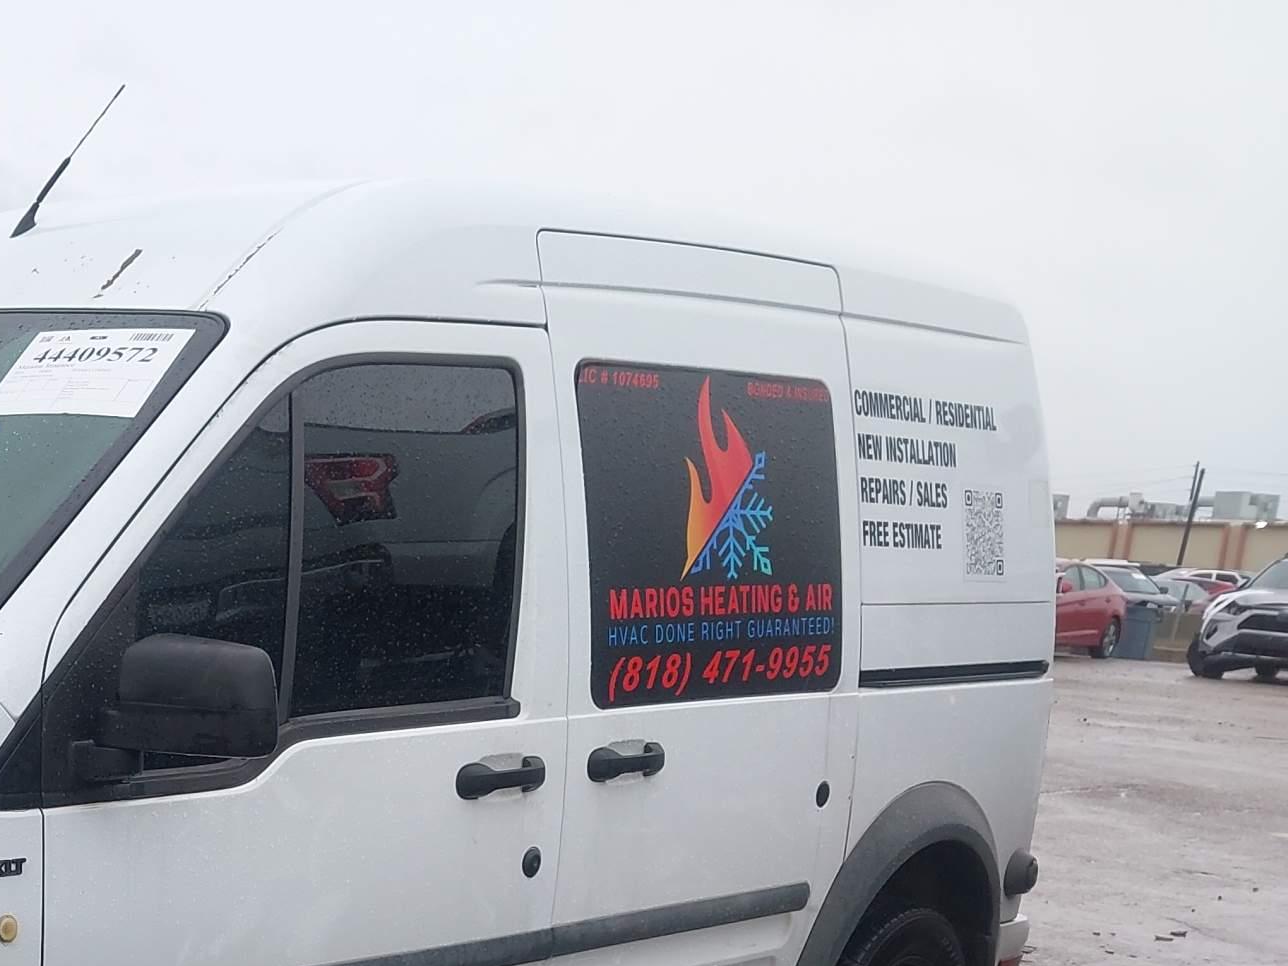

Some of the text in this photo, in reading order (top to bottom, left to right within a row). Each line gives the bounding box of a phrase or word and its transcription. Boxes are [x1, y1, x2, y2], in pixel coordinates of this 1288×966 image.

[33, 346, 159, 364] 44409572
[600, 368, 609, 385] #
[854, 389, 997, 431] COMMERCIAL / RESIDENTIAL
[858, 433, 957, 468] NEW INSTALLATION
[860, 476, 948, 509] REPAIRS / SALES
[862, 520, 943, 551] FREE ESTIMATE
[609, 583, 833, 619] MARIOS HEATING & AIR
[608, 616, 835, 646] HVAC DONE RIGHT GUARANTEED!
[608, 644, 832, 702] (818) 471-9955
